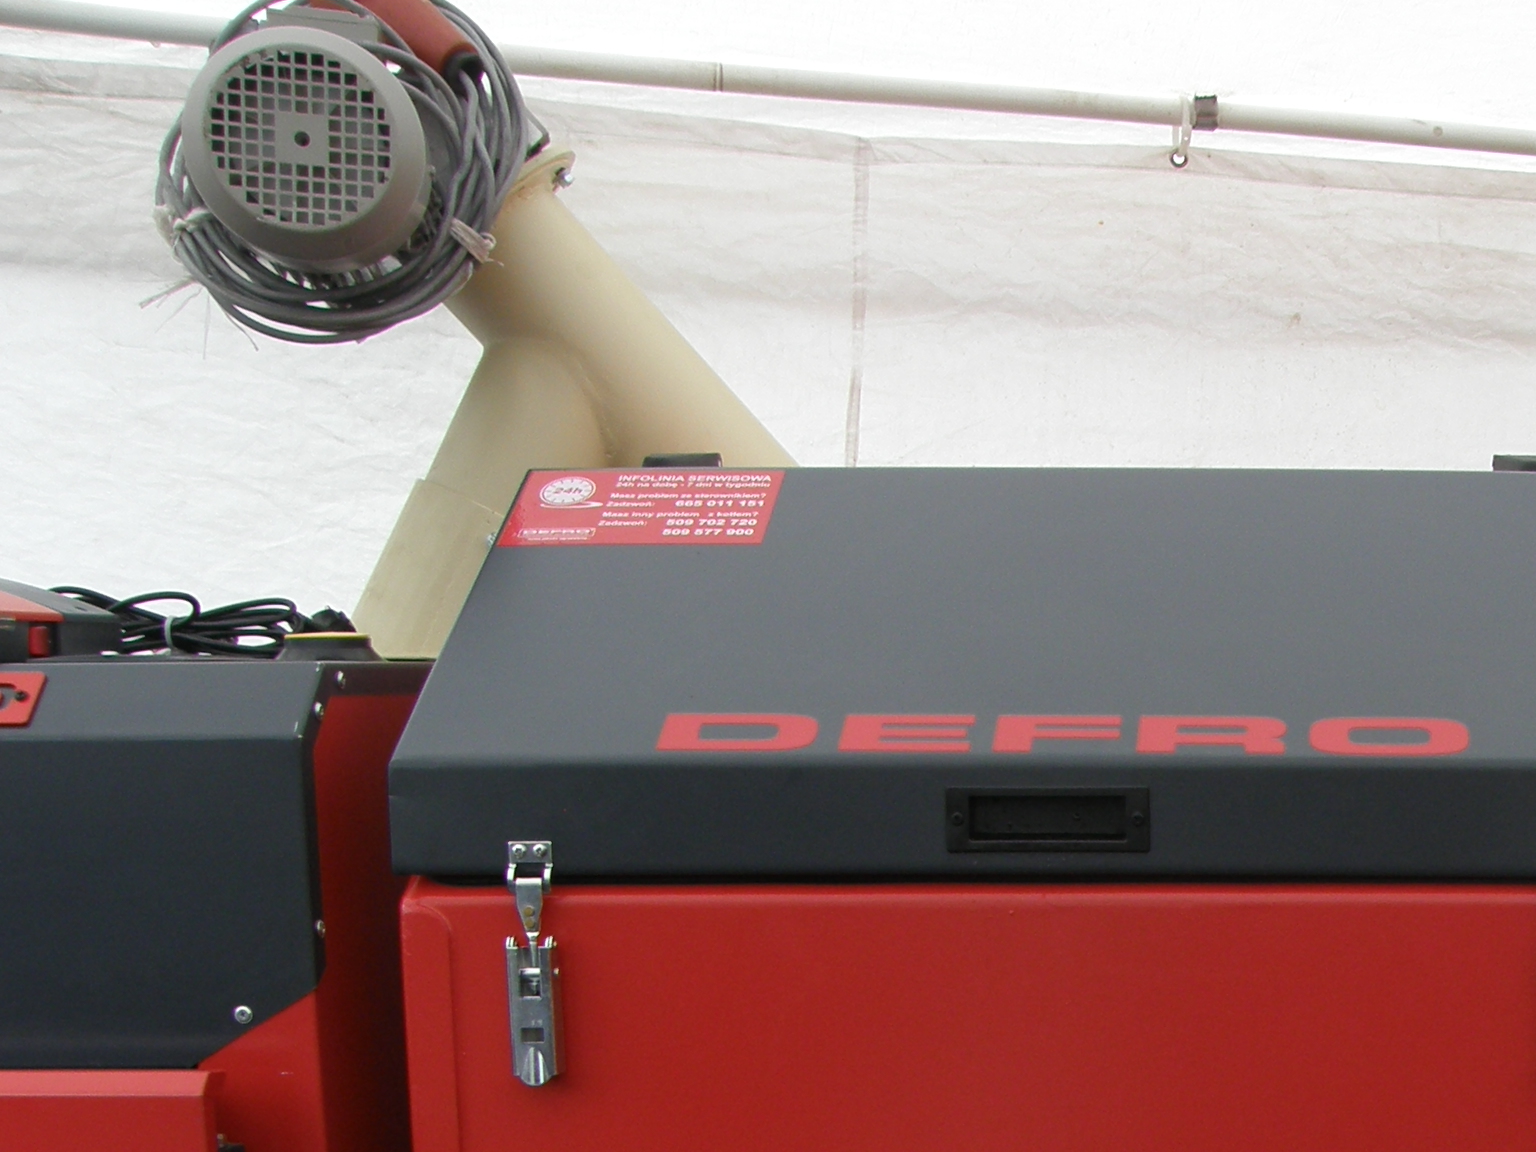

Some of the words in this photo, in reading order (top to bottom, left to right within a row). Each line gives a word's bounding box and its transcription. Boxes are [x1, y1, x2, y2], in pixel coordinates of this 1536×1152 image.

[662, 528, 691, 536] 509
[694, 528, 723, 536] 577
[726, 528, 754, 536] 900
[656, 712, 1470, 756] DEFRO
